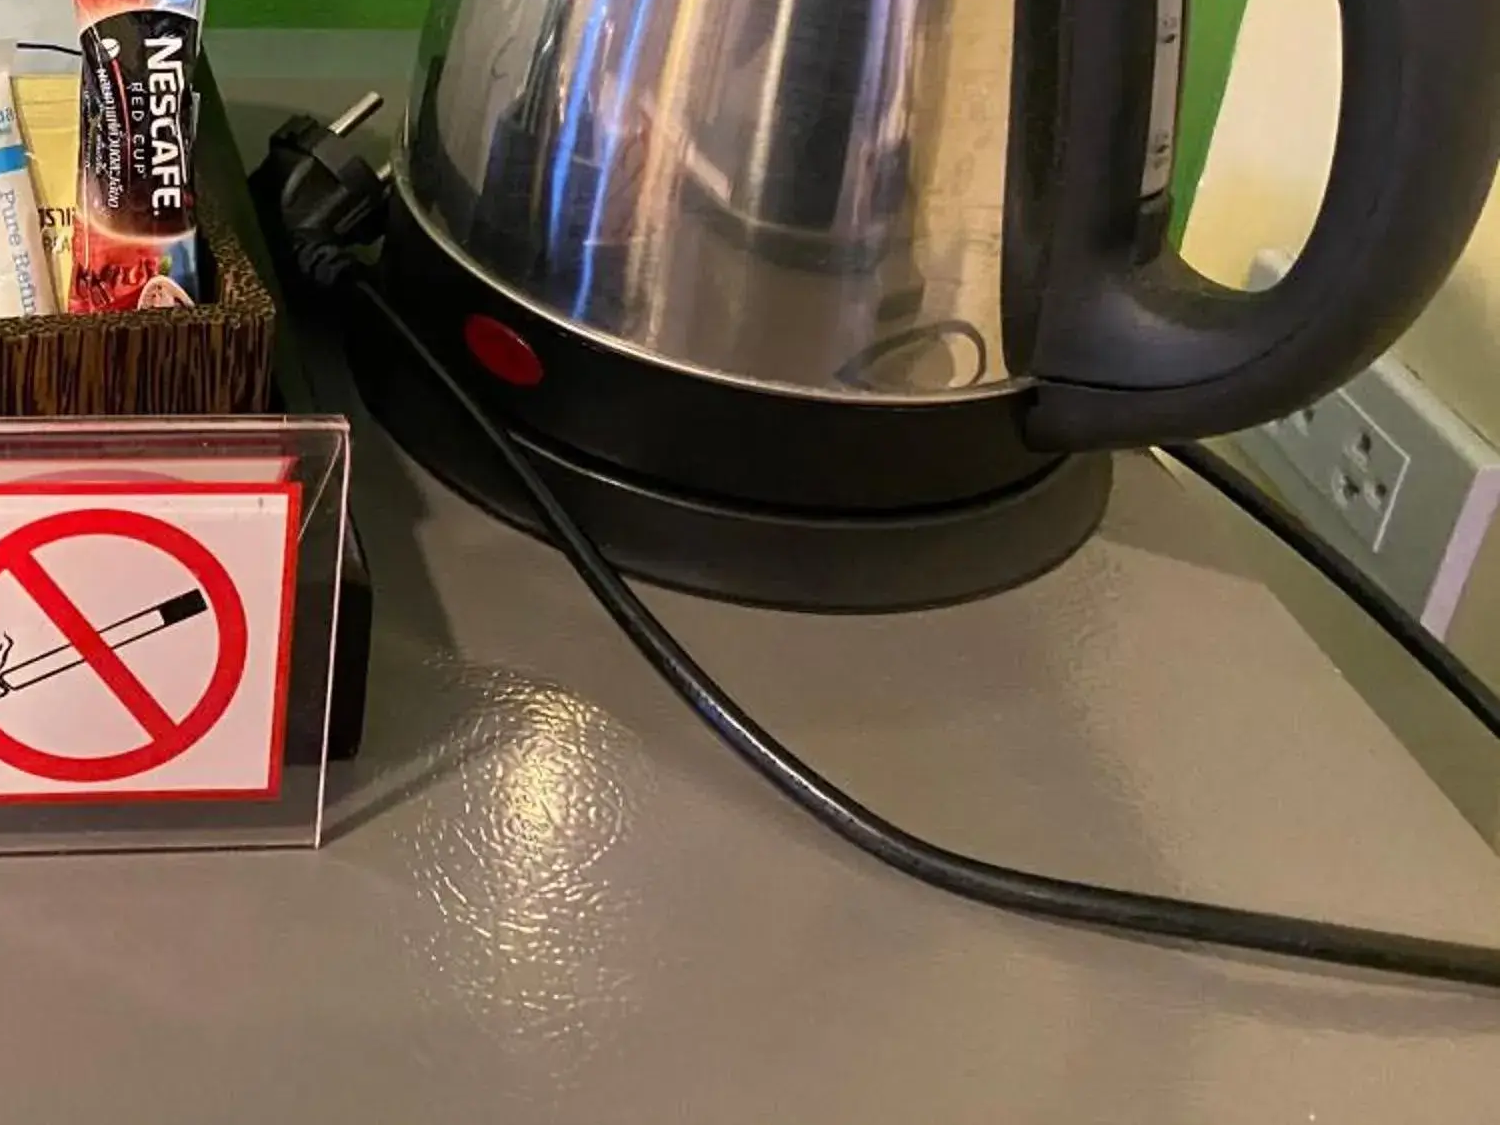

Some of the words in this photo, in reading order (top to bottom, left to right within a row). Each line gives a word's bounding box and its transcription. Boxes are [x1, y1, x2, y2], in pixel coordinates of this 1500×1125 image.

[130, 81, 146, 122] RED
[132, 135, 146, 175] CUP
[0, 188, 22, 247] Pure
